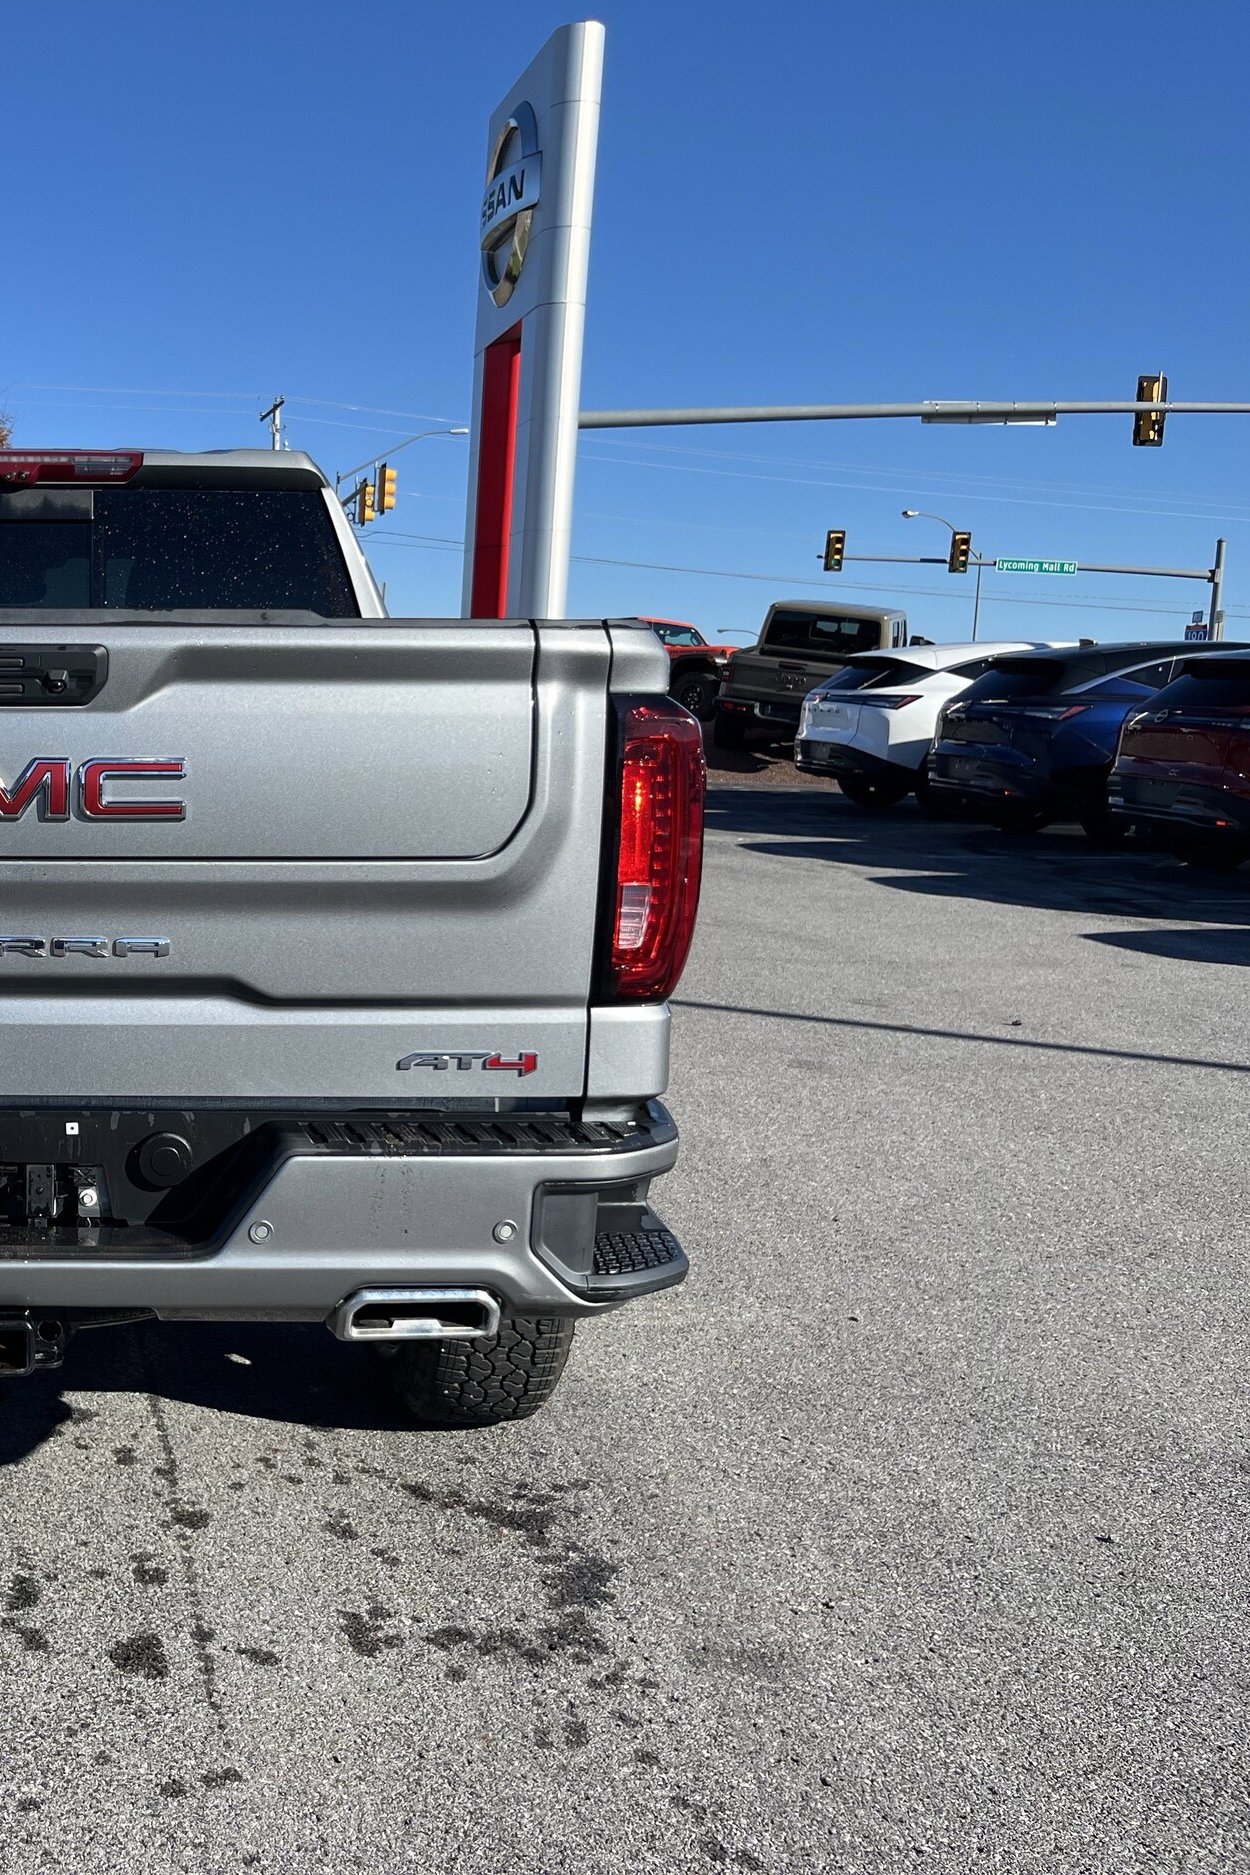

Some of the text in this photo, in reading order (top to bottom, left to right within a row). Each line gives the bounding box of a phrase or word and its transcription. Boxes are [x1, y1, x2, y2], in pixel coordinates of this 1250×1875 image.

[998, 561, 1039, 572] Lycoming
[1042, 564, 1061, 573] Mall
[396, 1050, 538, 1077] AT4
